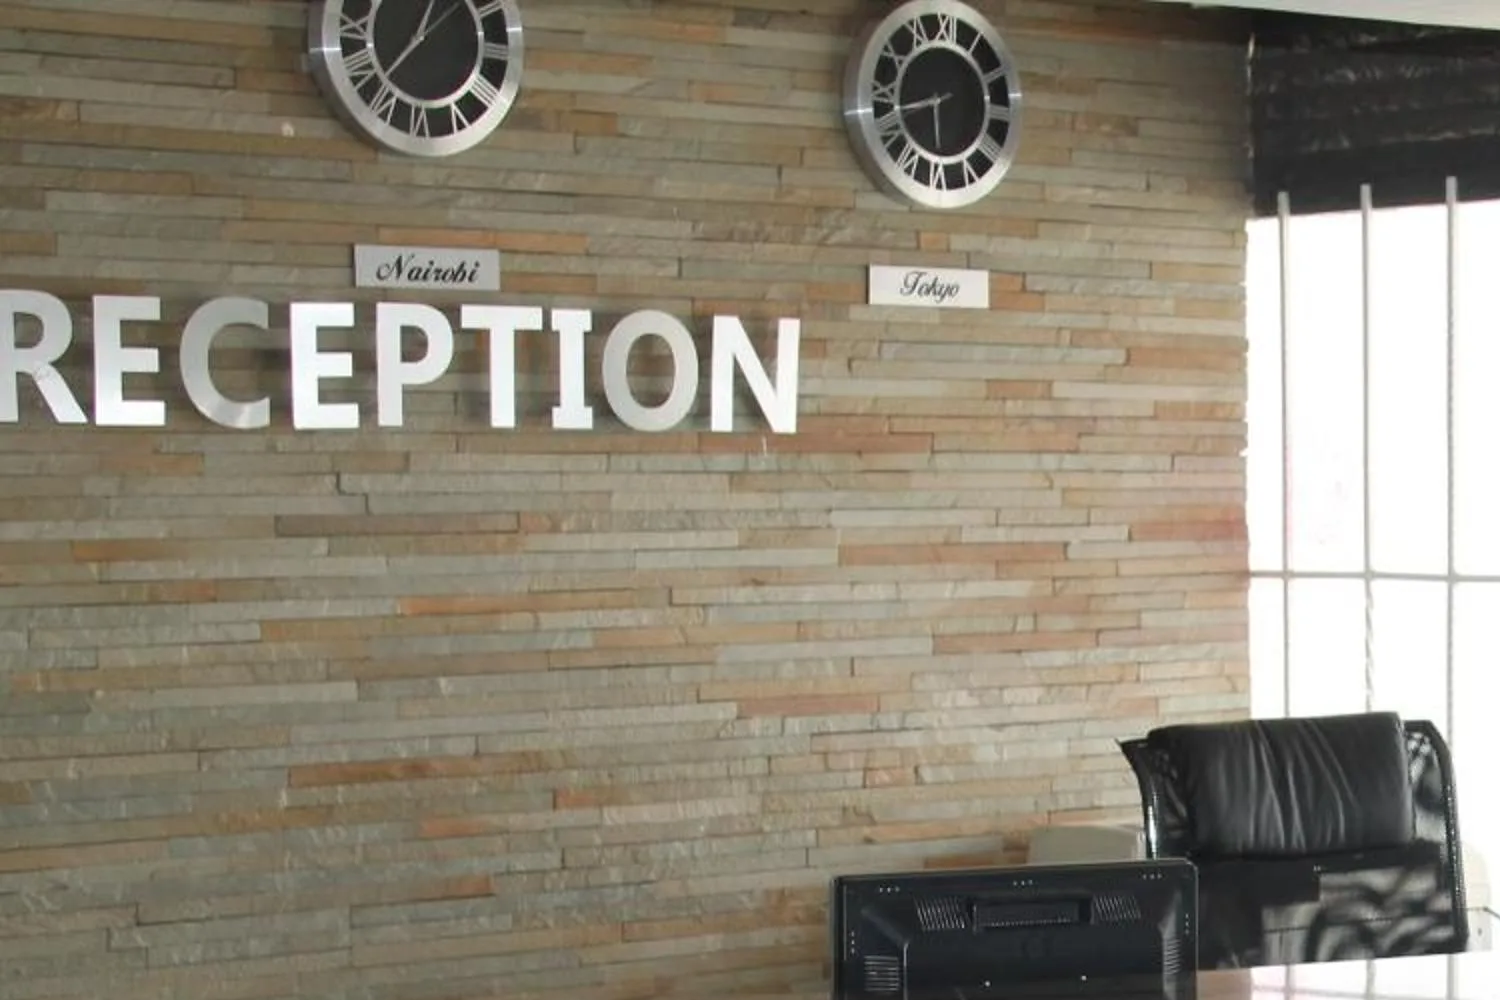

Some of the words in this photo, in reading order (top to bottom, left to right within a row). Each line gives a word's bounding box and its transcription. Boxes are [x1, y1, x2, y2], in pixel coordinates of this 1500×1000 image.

[376, 253, 481, 283] Nairobi
[900, 270, 960, 304] Tokyo
[0, 289, 800, 434] RECEPTION
